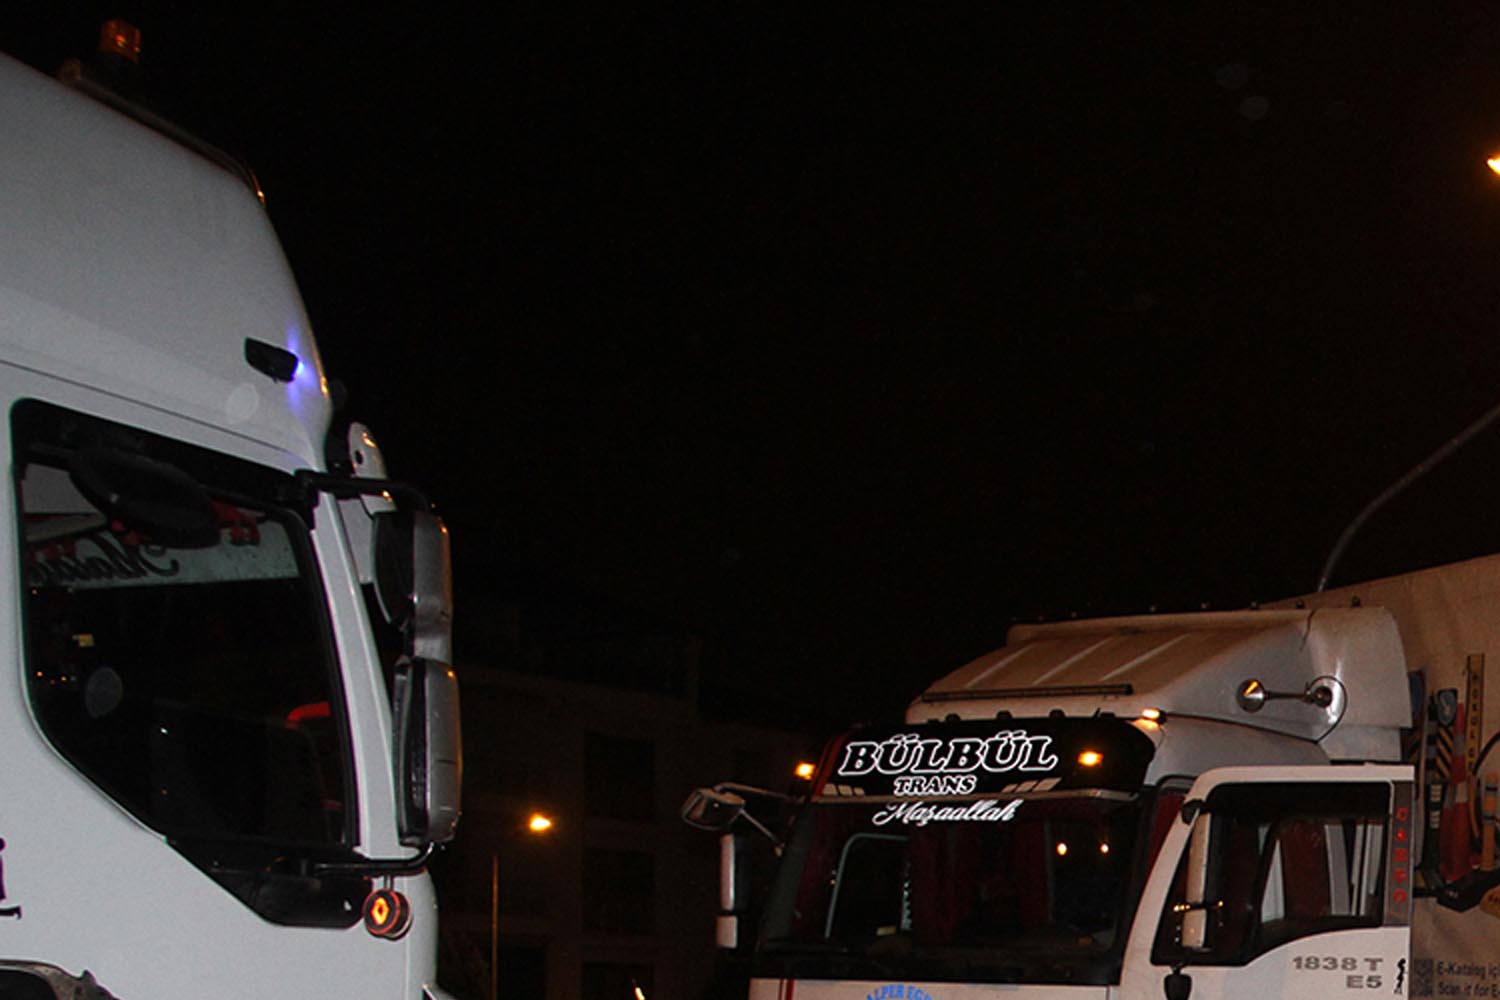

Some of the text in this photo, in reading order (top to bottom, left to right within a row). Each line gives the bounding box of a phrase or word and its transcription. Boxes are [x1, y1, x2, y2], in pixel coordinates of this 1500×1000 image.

[838, 730, 1058, 776] BÜLBÜL
[893, 775, 977, 797] TRANS
[872, 800, 1025, 827] Maşaallah
[1292, 955, 1357, 971] 1838
[1346, 975, 1382, 989] E5
